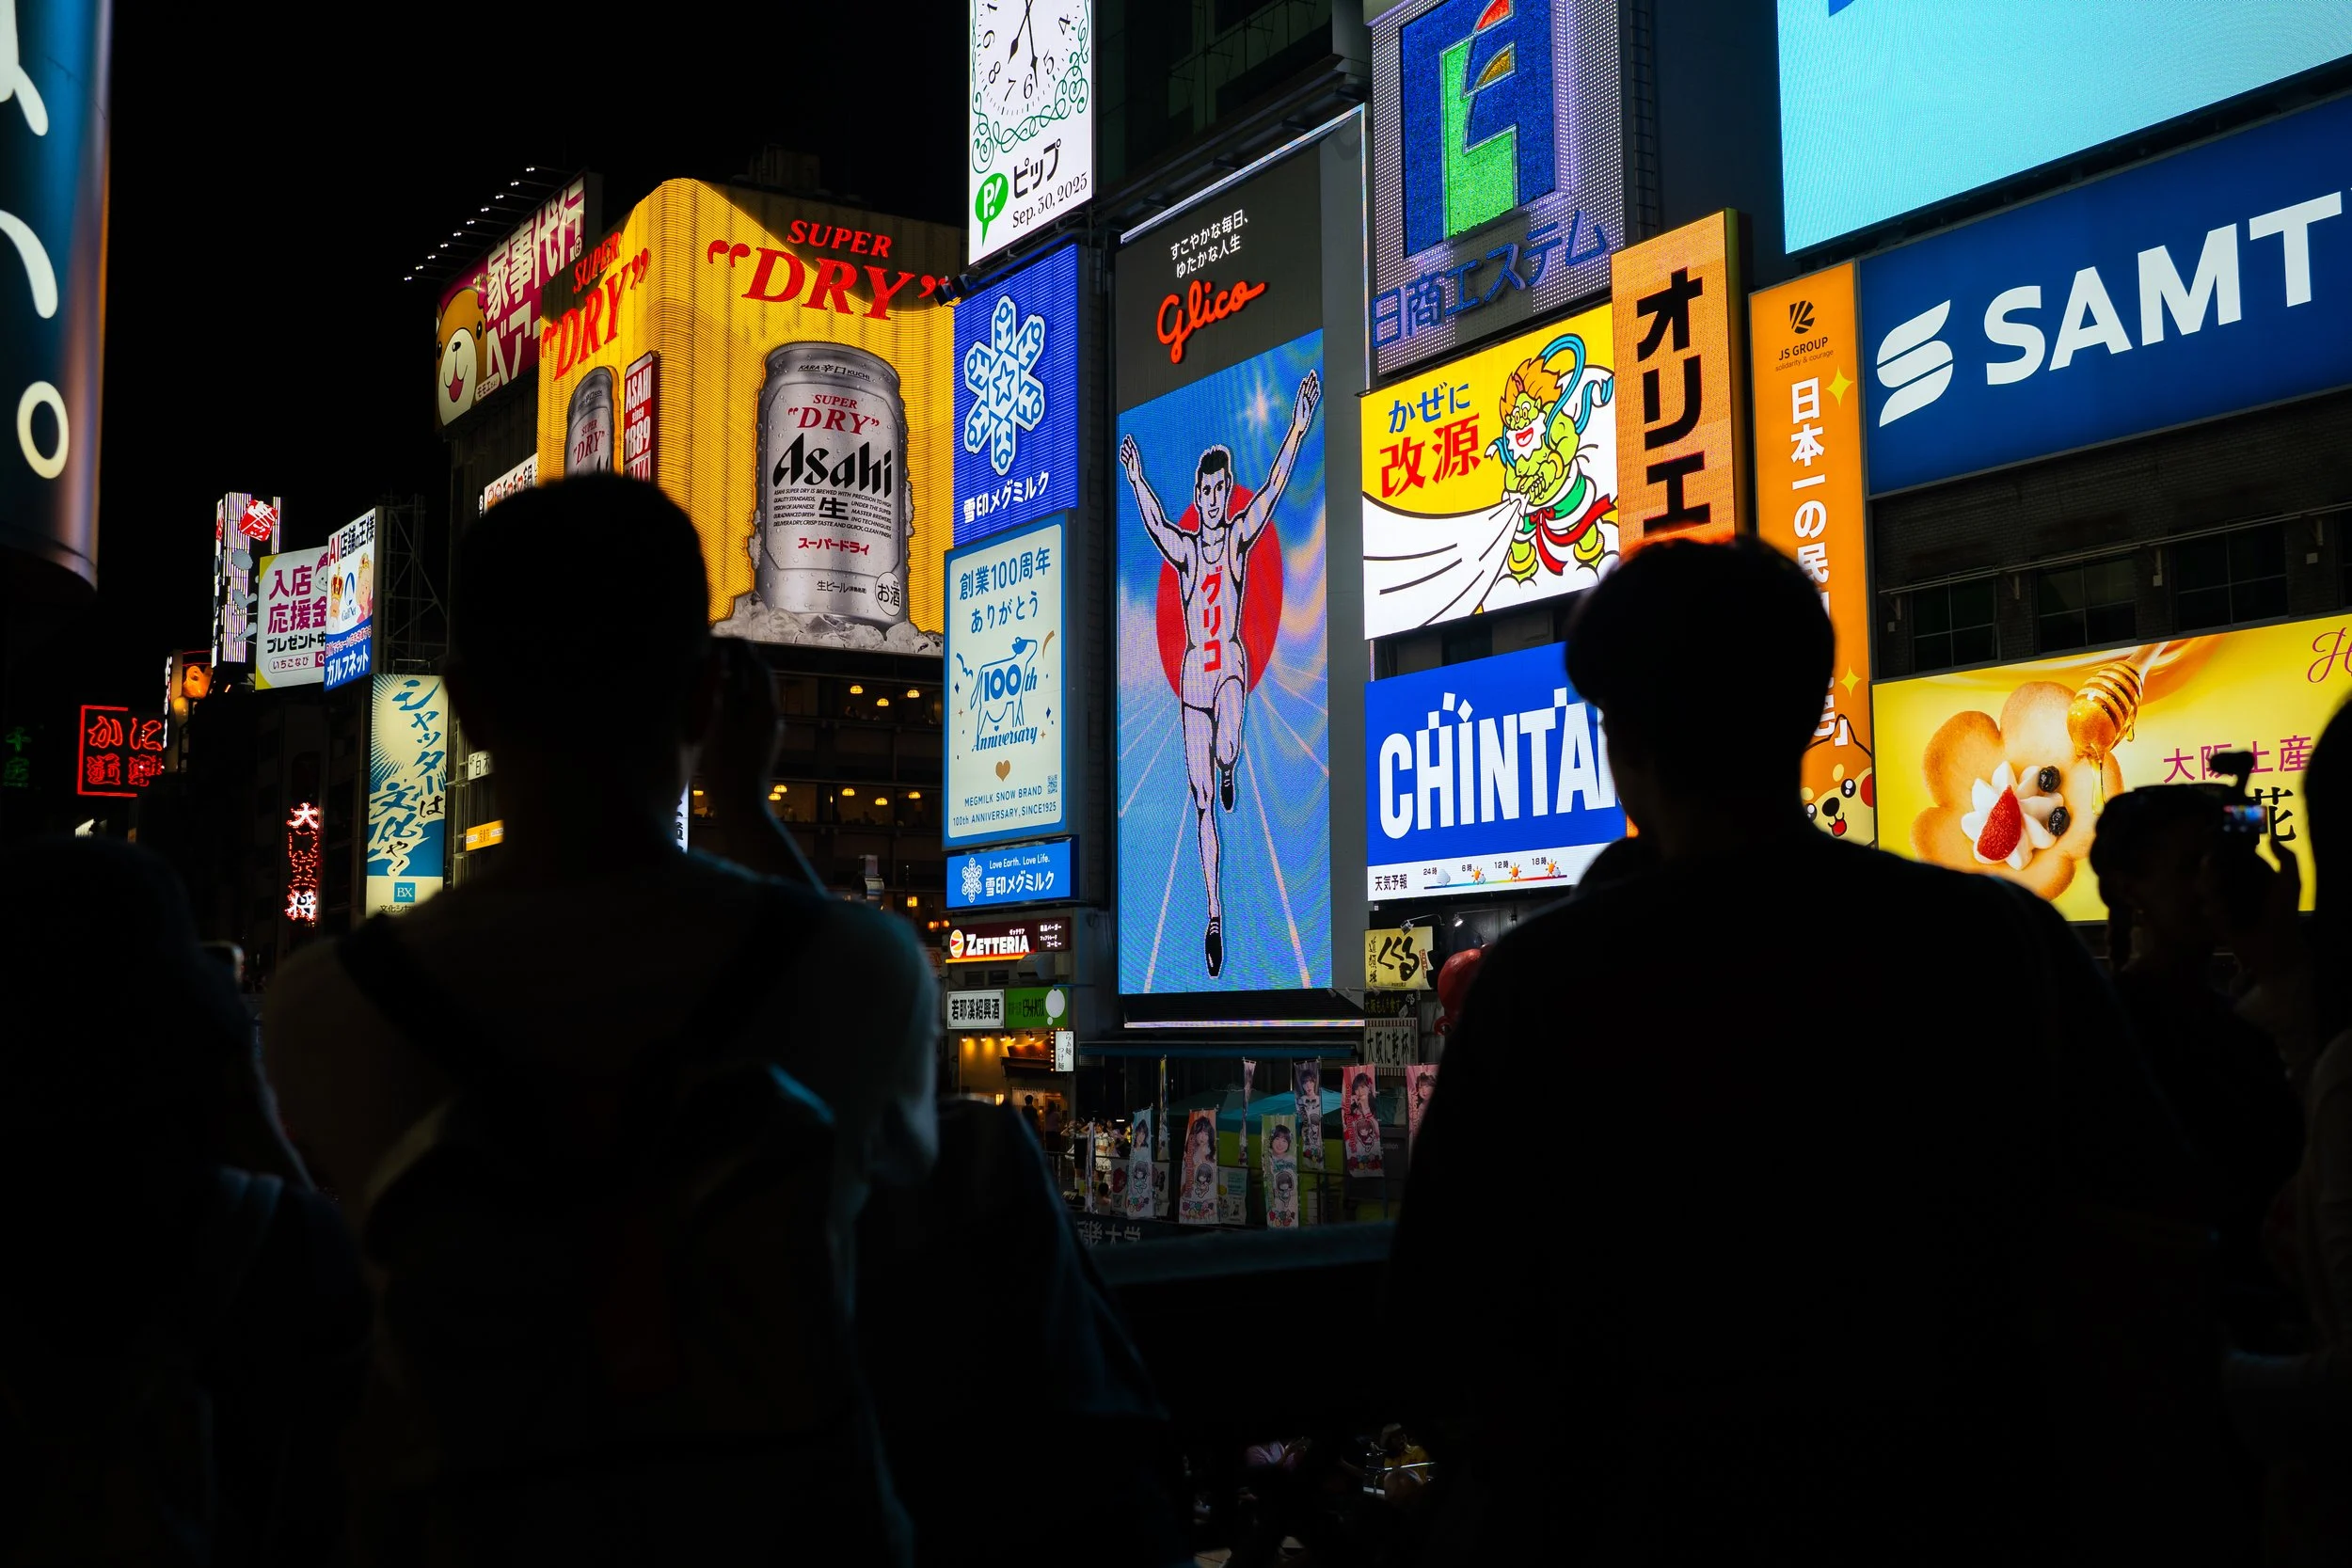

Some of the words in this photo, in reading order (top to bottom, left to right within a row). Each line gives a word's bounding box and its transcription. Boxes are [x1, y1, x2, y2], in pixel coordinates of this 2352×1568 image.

[1058, 14, 1072, 35] 4
[983, 30, 995, 49] 9
[988, 61, 1001, 85] 8
[1043, 50, 1055, 75] 5
[1004, 78, 1017, 102] 7
[1023, 73, 1033, 100] 6
[1013, 138, 1062, 199] ピップ
[787, 219, 892, 258] SUPER
[1170, 209, 1248, 261] すこやかな毎日、
[573, 231, 622, 294] SUPER
[1176, 233, 1241, 278] ゆたかな人生
[1372, 210, 1606, 348] 日商エステム
[1983, 190, 2352, 386] SAMT
[1156, 279, 1265, 363] Glico
[1775, 359, 1802, 372] solidarity
[1809, 349, 1834, 362] courage
[1779, 348, 1790, 361] JS
[1792, 337, 1828, 356] GROUP
[798, 364, 820, 372] KARA
[848, 370, 870, 381] KUCHI
[626, 367, 651, 414] ASAHI
[813, 394, 857, 410] SUPER
[1637, 265, 1710, 537] オリエ
[632, 405, 644, 423] since
[1389, 381, 1470, 434] かぜに
[581, 420, 597, 436] SUPER
[625, 416, 651, 462] 1889
[772, 433, 892, 499] Asahi
[1379, 413, 1481, 499] 改源
[818, 497, 849, 520] 生
[851, 500, 868, 509] UNDER
[852, 493, 876, 502] PRECISION
[963, 471, 1049, 523] 雪印メグミルク
[1790, 377, 1830, 617] 日本一の民
[851, 509, 872, 518] MASTER
[862, 518, 892, 531] TECHNIQUES
[864, 527, 879, 535] CLEAN
[798, 537, 870, 556] スーパードライ
[269, 565, 312, 600] 入店
[960, 546, 1051, 600] 創業100周年
[877, 583, 900, 608] お酒
[267, 598, 326, 635] 応援金
[971, 591, 1038, 633] ありがとう
[1200, 564, 1223, 673] グリコ
[273, 657, 309, 669] いちごなび
[326, 645, 369, 686] ガルフネット
[87, 716, 163, 751] かに
[972, 725, 1038, 752] Anniversary
[964, 793, 993, 807] MEGMILK
[995, 789, 1016, 802] SNOW
[1018, 785, 1042, 799] BRAND
[953, 816, 969, 826] 100th
[990, 858, 1003, 869] Love
[1003, 856, 1021, 868] Earth.
[1023, 855, 1036, 865] Love
[1037, 853, 1051, 864] Life.
[1422, 867, 1438, 876] 24時
[1462, 863, 1472, 872] 6時
[1494, 861, 1509, 869] 12時
[1532, 857, 1547, 865] 18時
[397, 887, 413, 897] BX
[985, 870, 1055, 896] 雪印メグミルク
[1375, 874, 1407, 892] 天気予報
[380, 905, 416, 913] 文化シャ
[966, 934, 1030, 956] ZETTERIA
